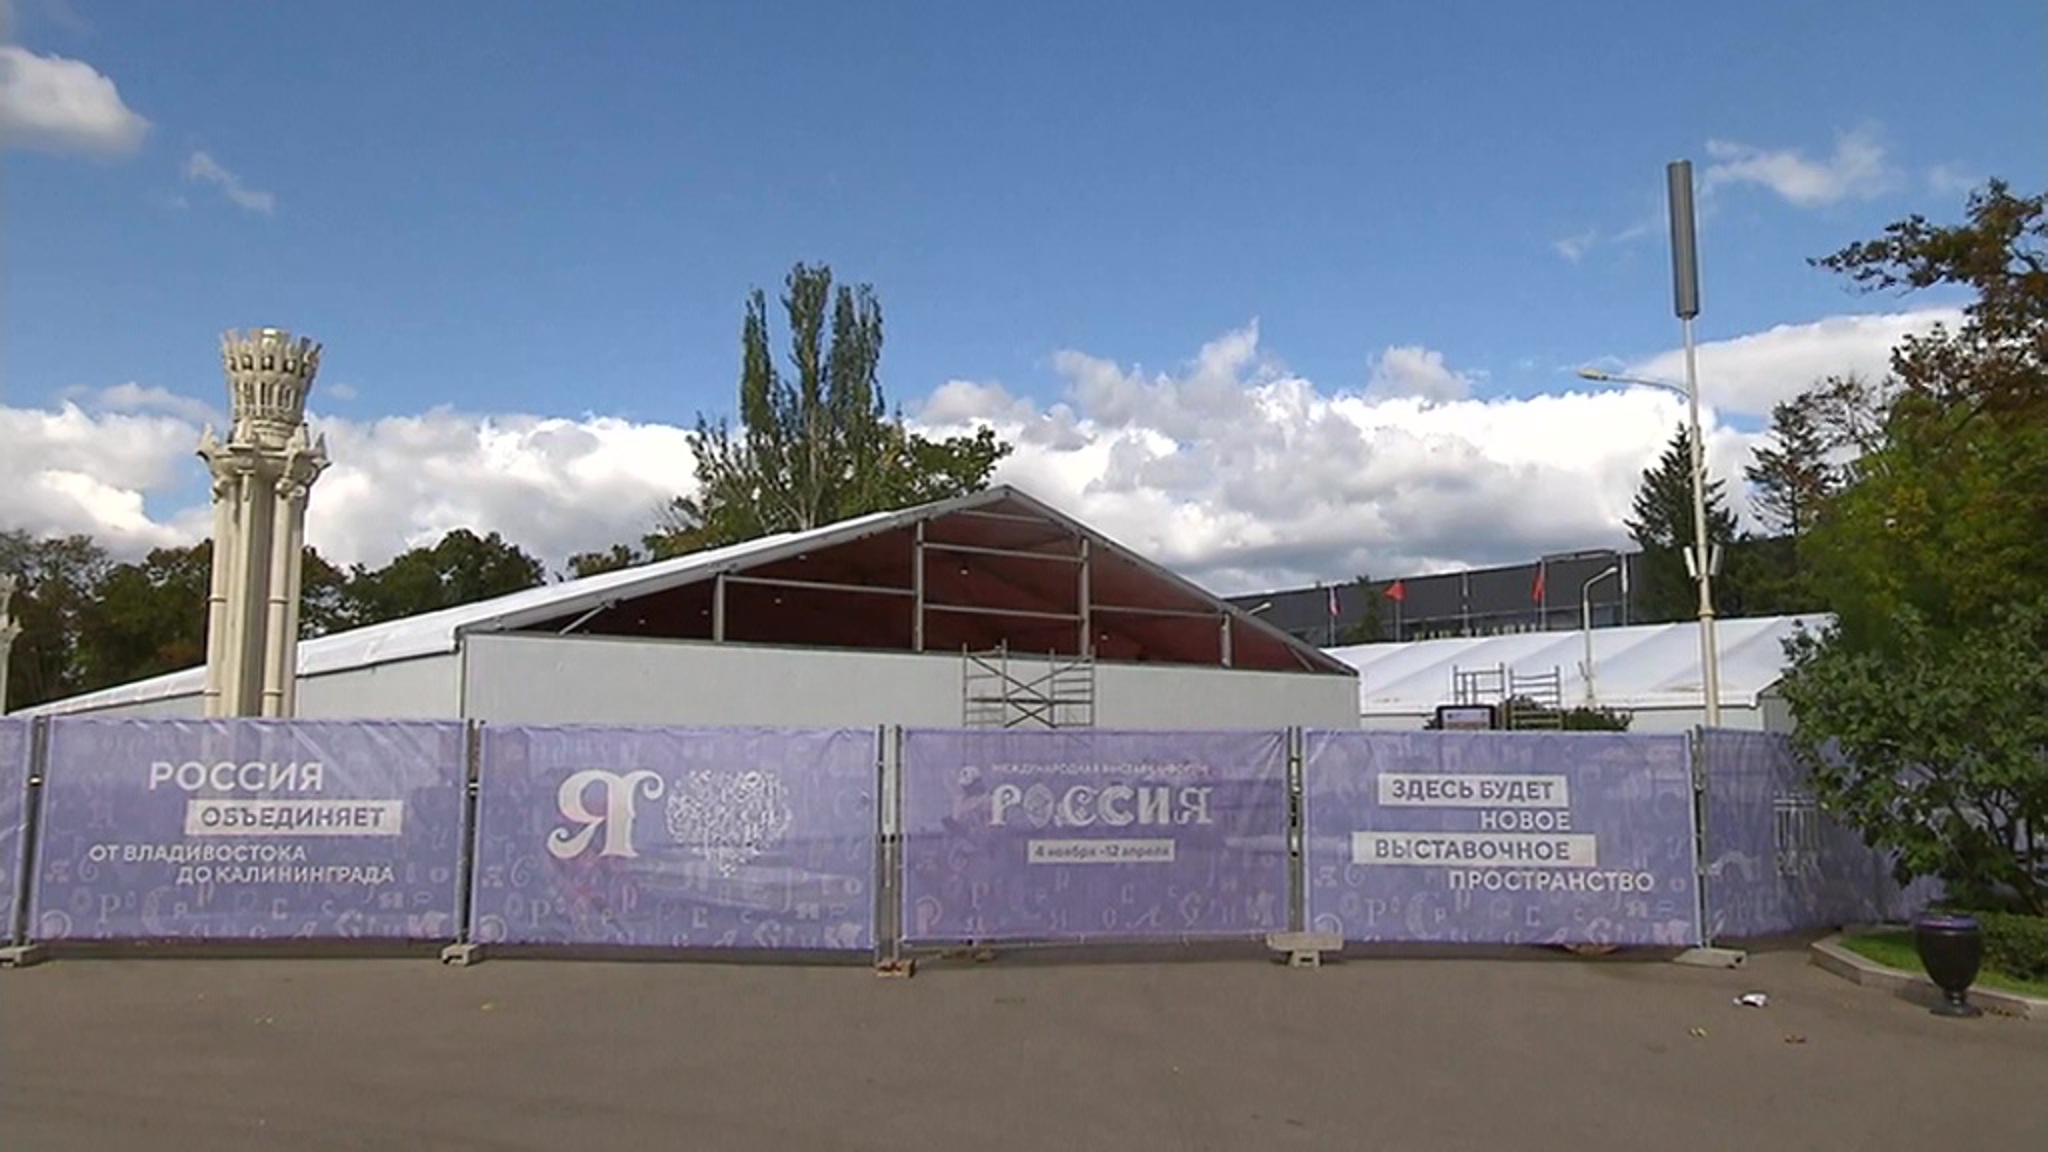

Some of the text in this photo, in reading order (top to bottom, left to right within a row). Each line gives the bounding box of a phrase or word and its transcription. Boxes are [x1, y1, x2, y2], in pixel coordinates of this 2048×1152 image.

[149, 761, 324, 792] РОССИЯ
[1392, 780, 1553, 800] ЗДЕСЬ БУДЕТ
[547, 769, 664, 860] Я
[989, 784, 1213, 828] РОССИЯ
[202, 806, 386, 828] ОБЪЕДИНЯЕТ
[1481, 811, 1571, 830] НОВОЕ
[90, 844, 307, 863] ОТ ВЛАДИВОСТОКА
[1375, 840, 1570, 861] ВЫСТАВОЧНОЕ
[176, 866, 396, 885] ДО КАЛИНИНГРАДА
[1449, 871, 1654, 892] ПРОСТРАНСТВО
